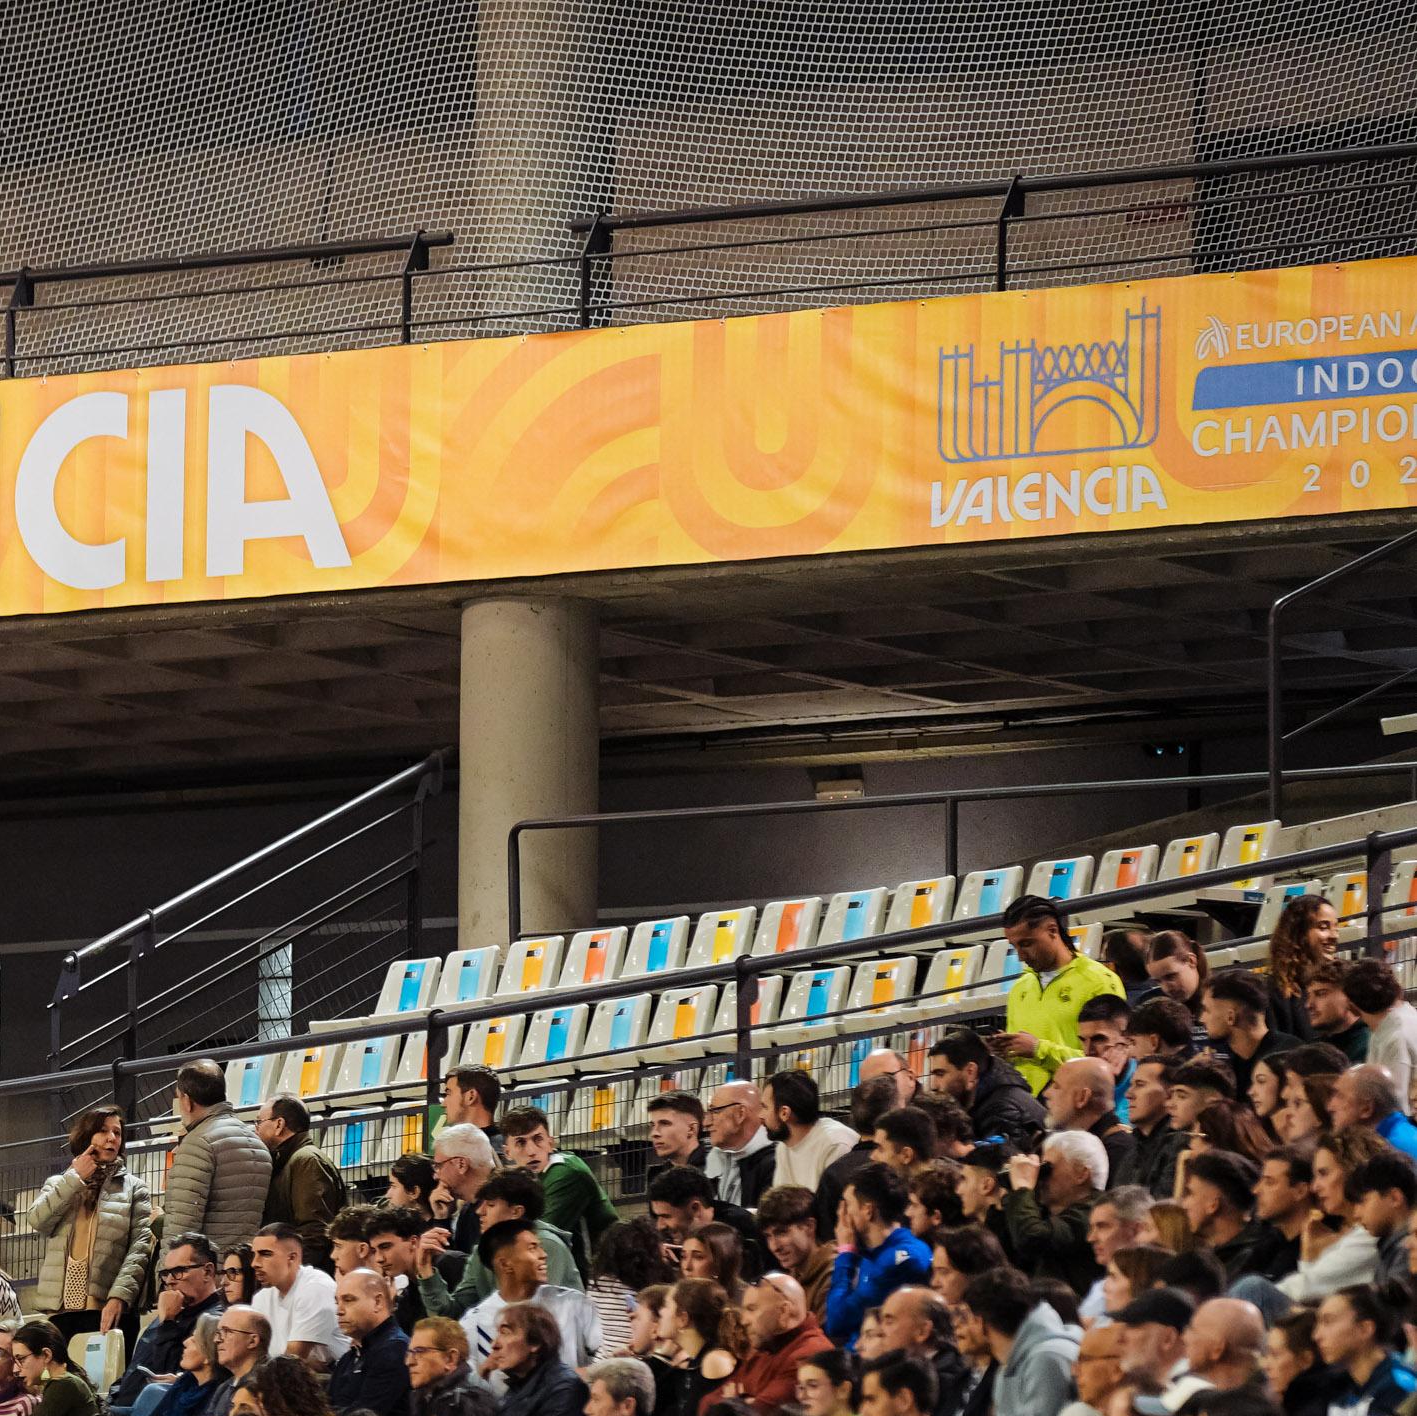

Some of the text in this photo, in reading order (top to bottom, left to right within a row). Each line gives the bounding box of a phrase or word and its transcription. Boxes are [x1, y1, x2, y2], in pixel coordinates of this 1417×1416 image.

[1236, 311, 1401, 350] EUROPEAN
[1297, 357, 1417, 395] INDO
[1192, 403, 1417, 455] CHAMPIO
[931, 465, 1168, 528] VALENCIA
